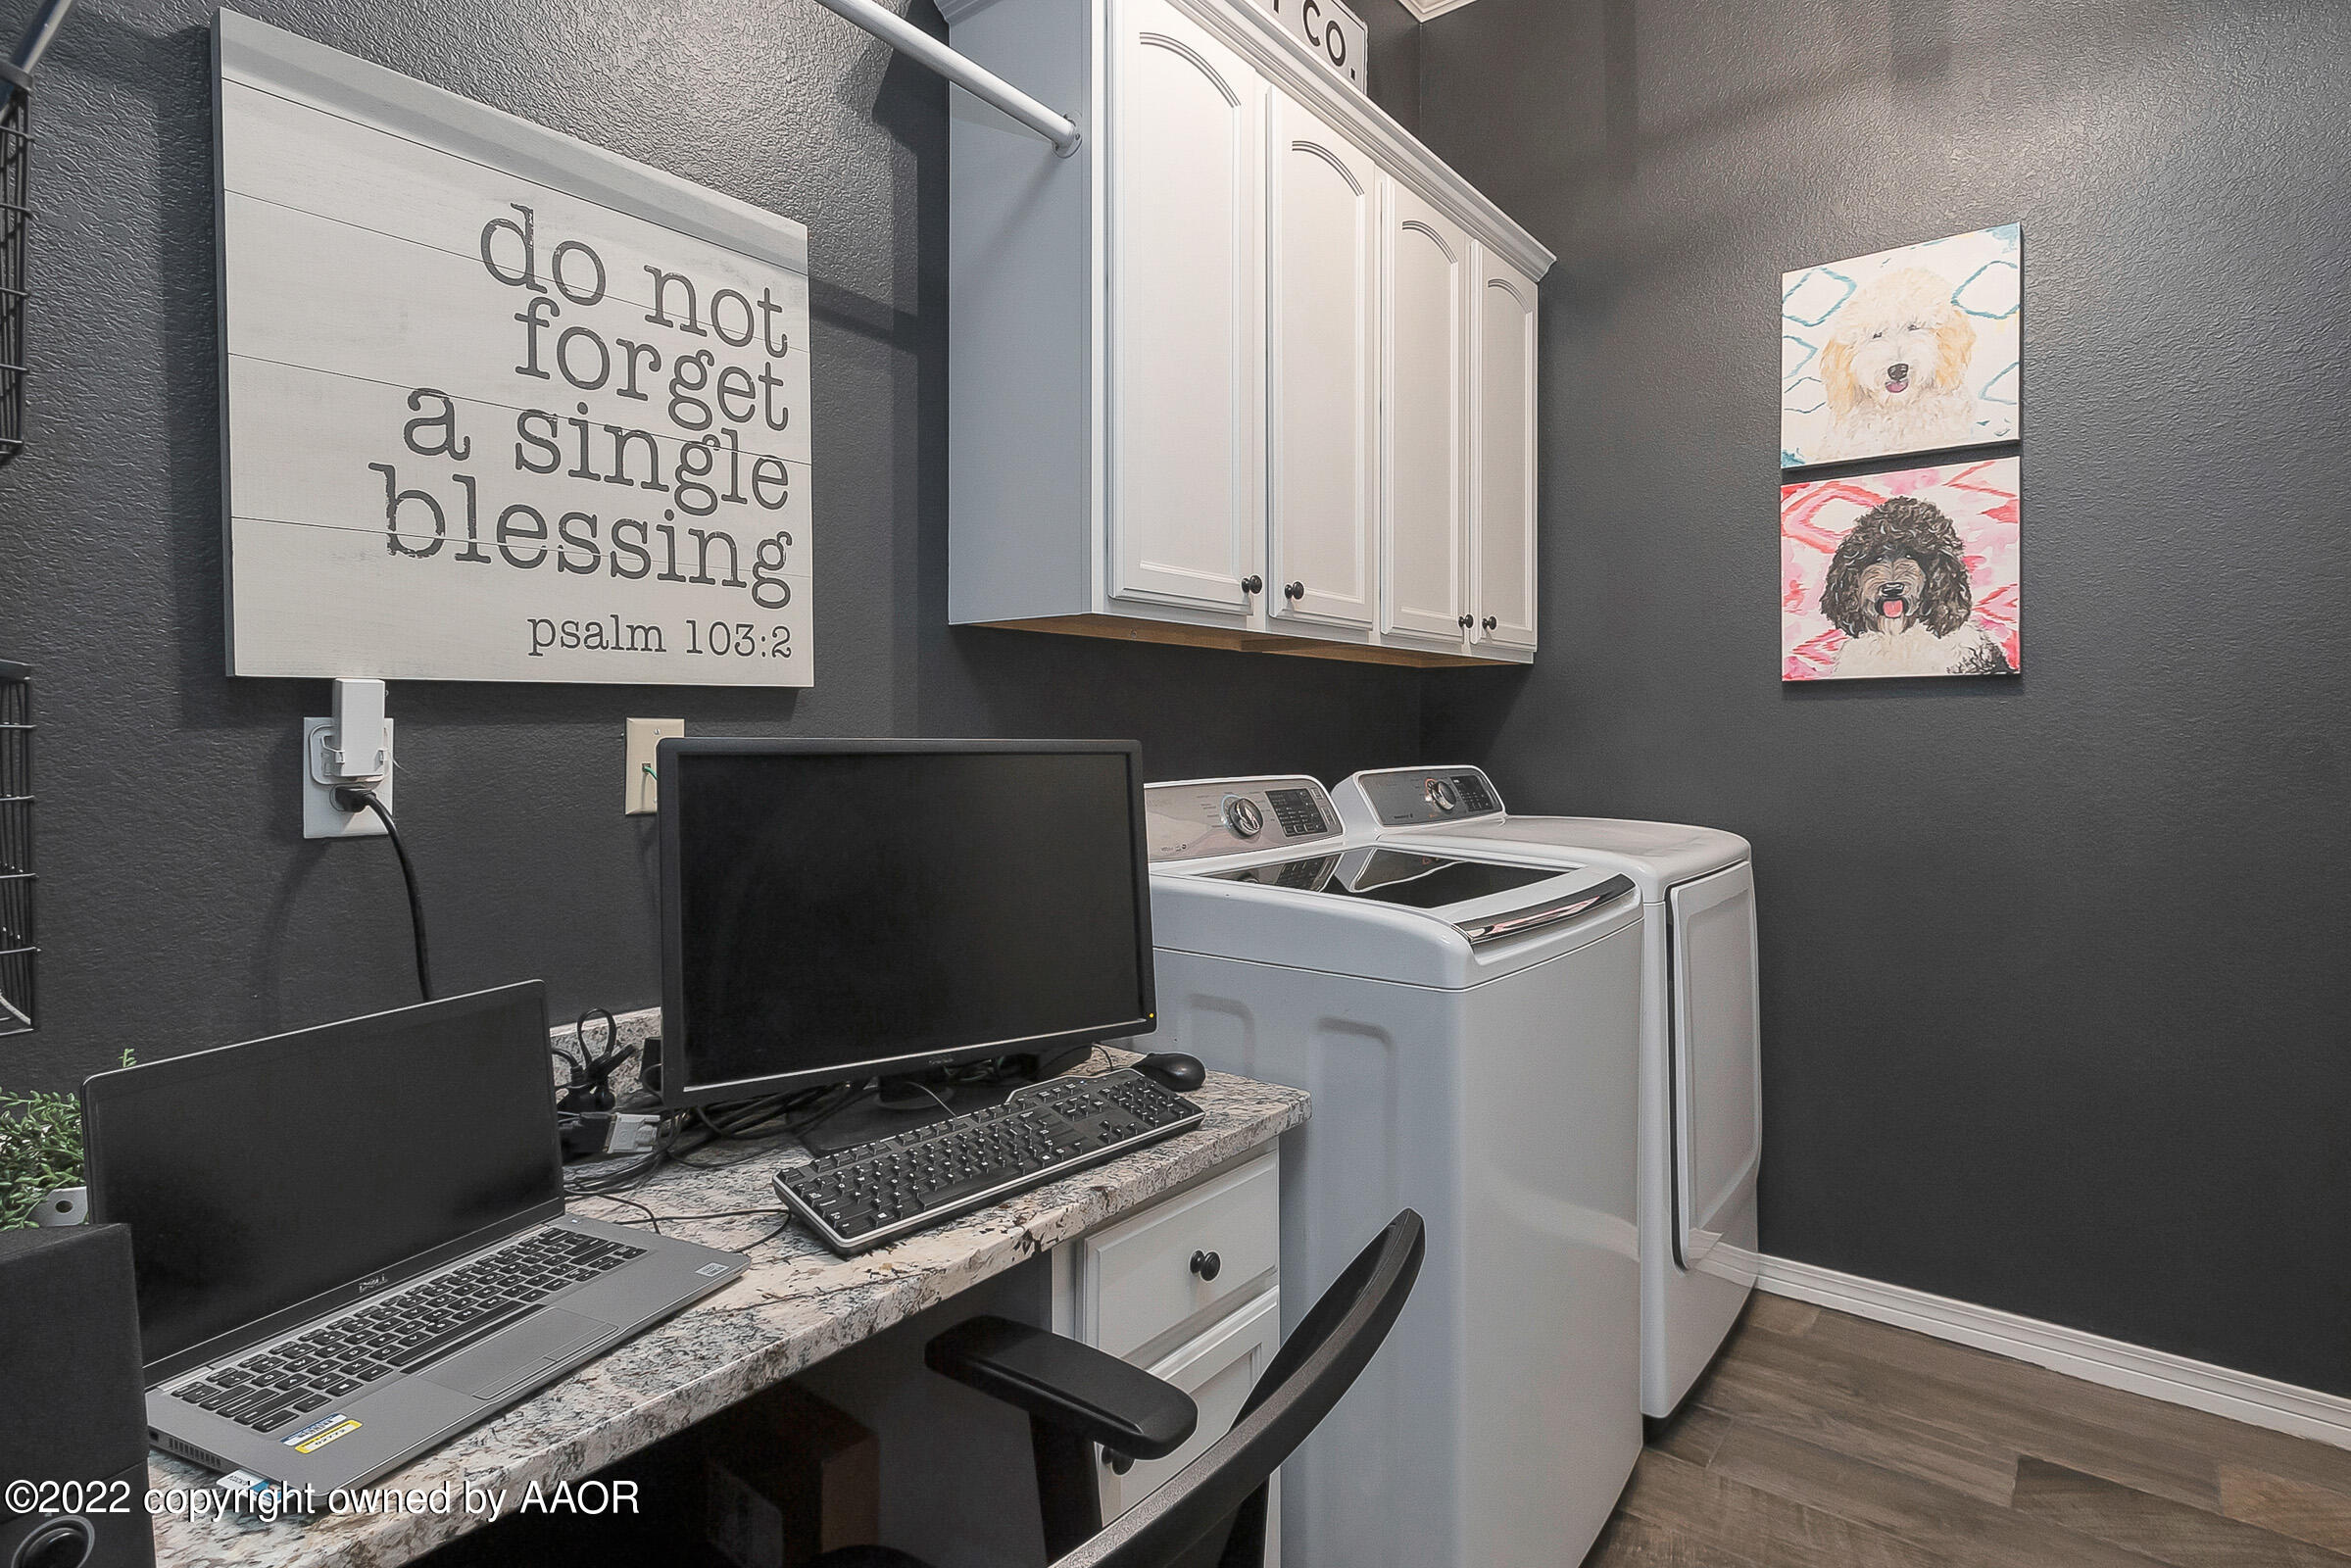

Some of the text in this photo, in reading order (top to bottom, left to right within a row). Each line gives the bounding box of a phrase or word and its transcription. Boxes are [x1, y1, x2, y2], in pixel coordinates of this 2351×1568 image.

[480, 202, 788, 359] do not
[514, 296, 789, 432] forget
[403, 387, 789, 516] a single
[367, 462, 793, 610] blessing
[526, 613, 793, 659] psalm 103:2
